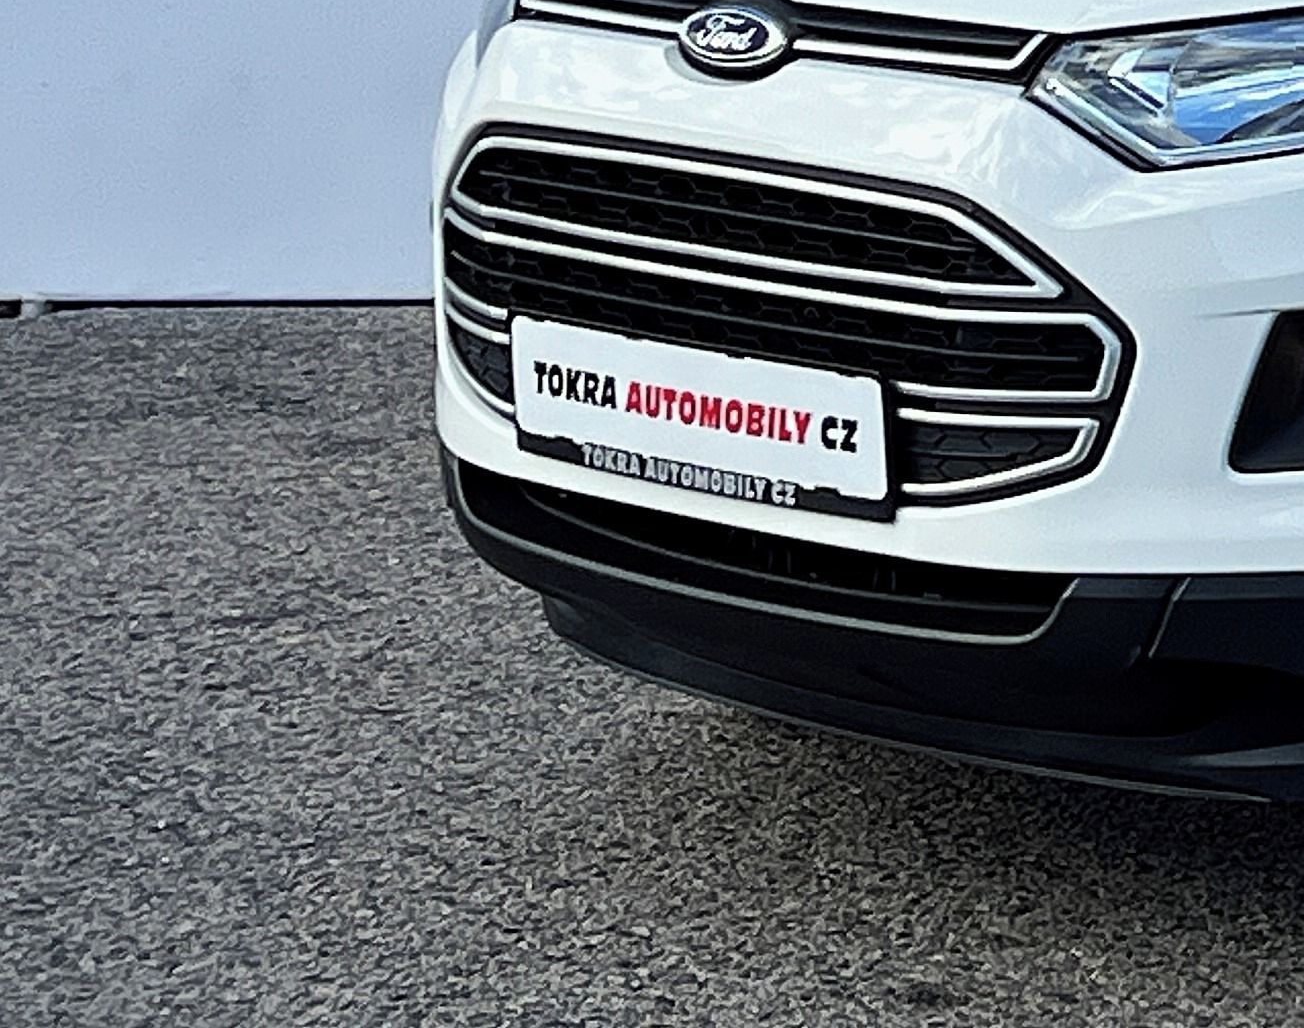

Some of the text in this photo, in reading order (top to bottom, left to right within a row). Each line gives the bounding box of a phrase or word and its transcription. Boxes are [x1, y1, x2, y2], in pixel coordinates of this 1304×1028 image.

[695, 14, 758, 51] Ford
[534, 360, 858, 454] TOKRA AUTOMOBILY CZ
[581, 443, 797, 507] TOKRA AUTOMOBILY CZ
